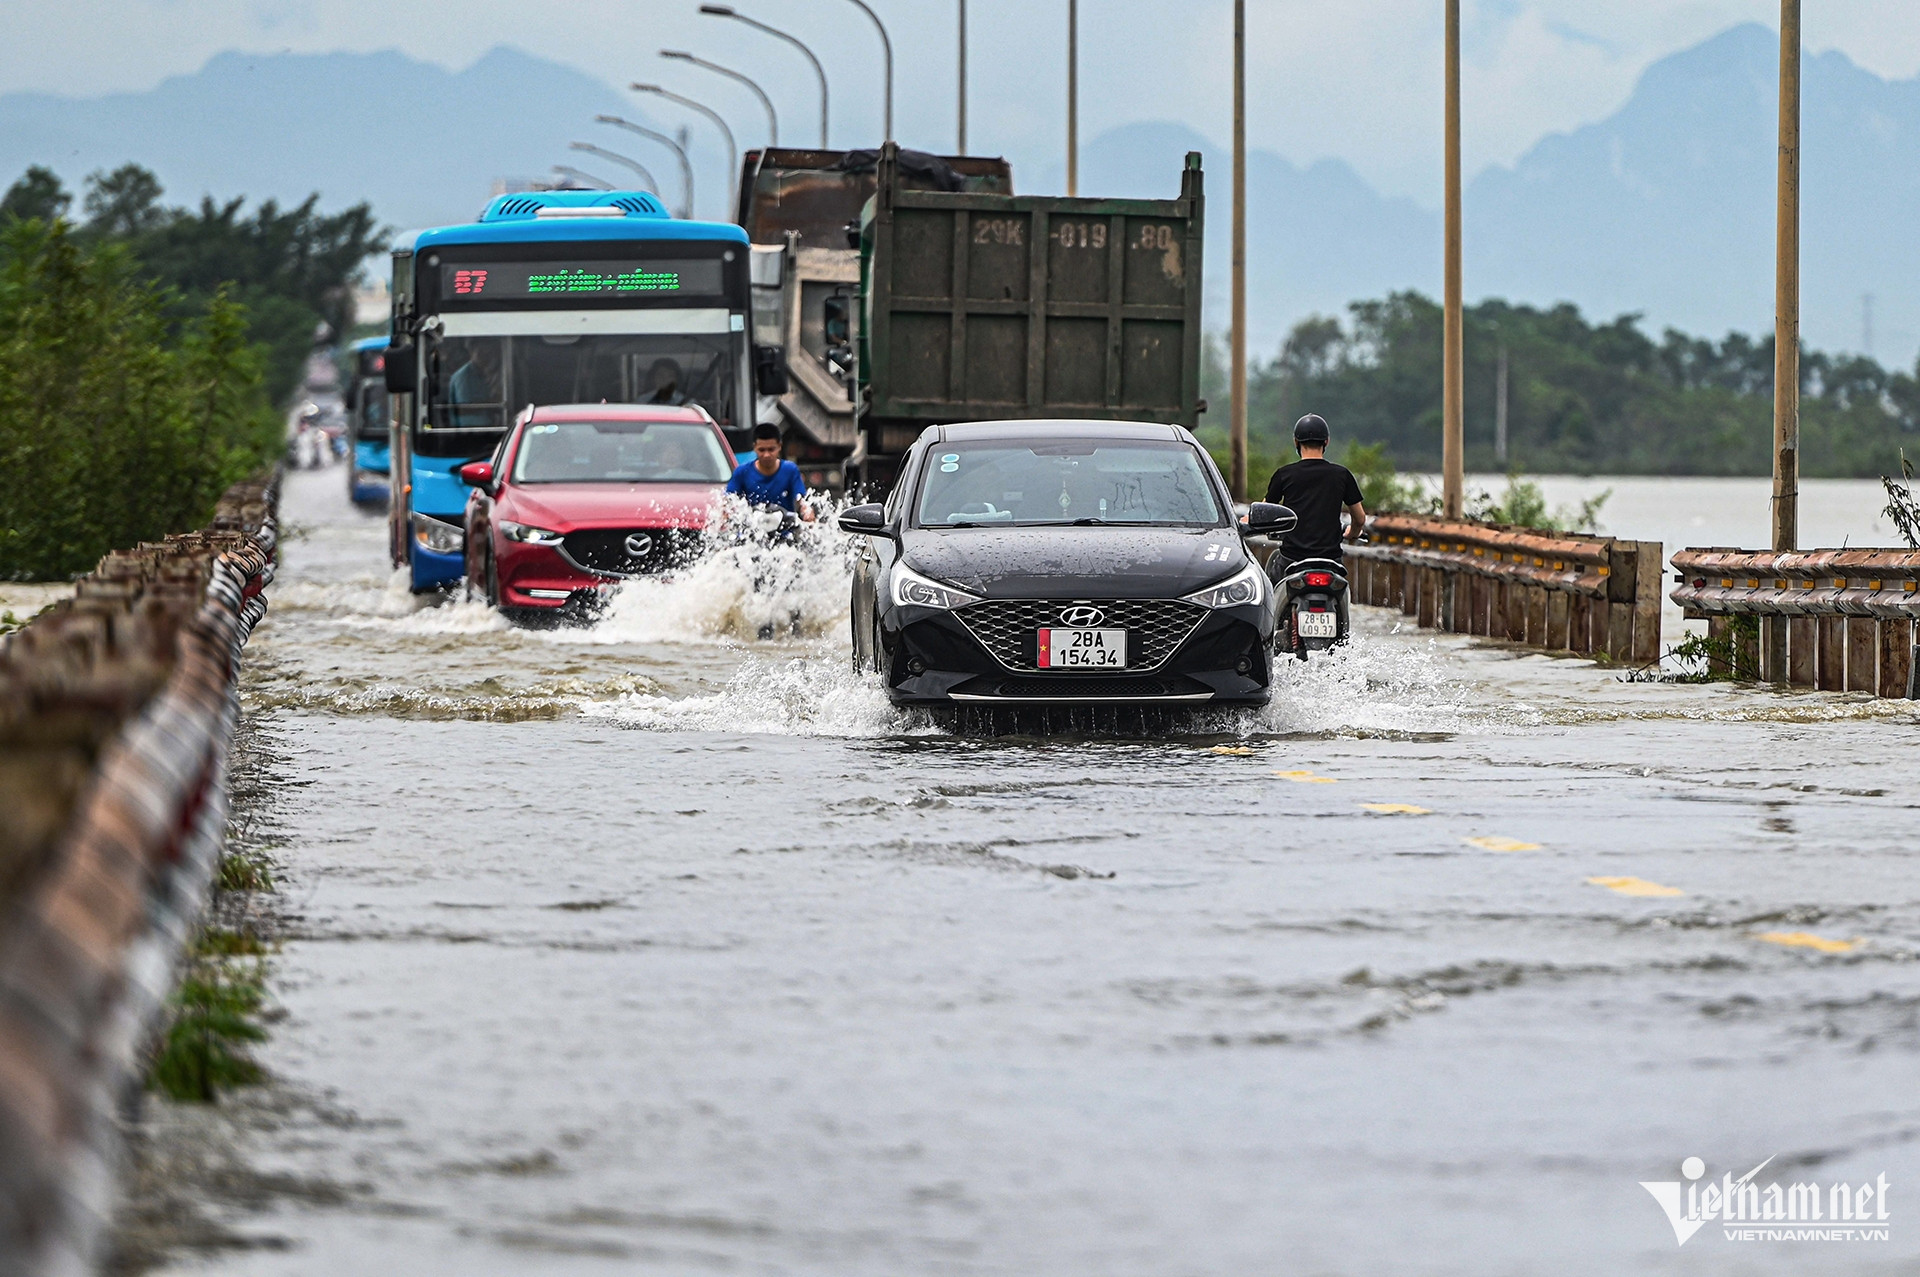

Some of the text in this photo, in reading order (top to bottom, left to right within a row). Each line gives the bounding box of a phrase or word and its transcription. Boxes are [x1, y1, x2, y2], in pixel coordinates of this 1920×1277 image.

[974, 219, 1024, 245] 29K
[1305, 614, 1330, 625] 28-G1
[1302, 625, 1333, 636] 409.37
[1071, 631, 1104, 648] 28A
[1060, 649, 1118, 665] 154.34
